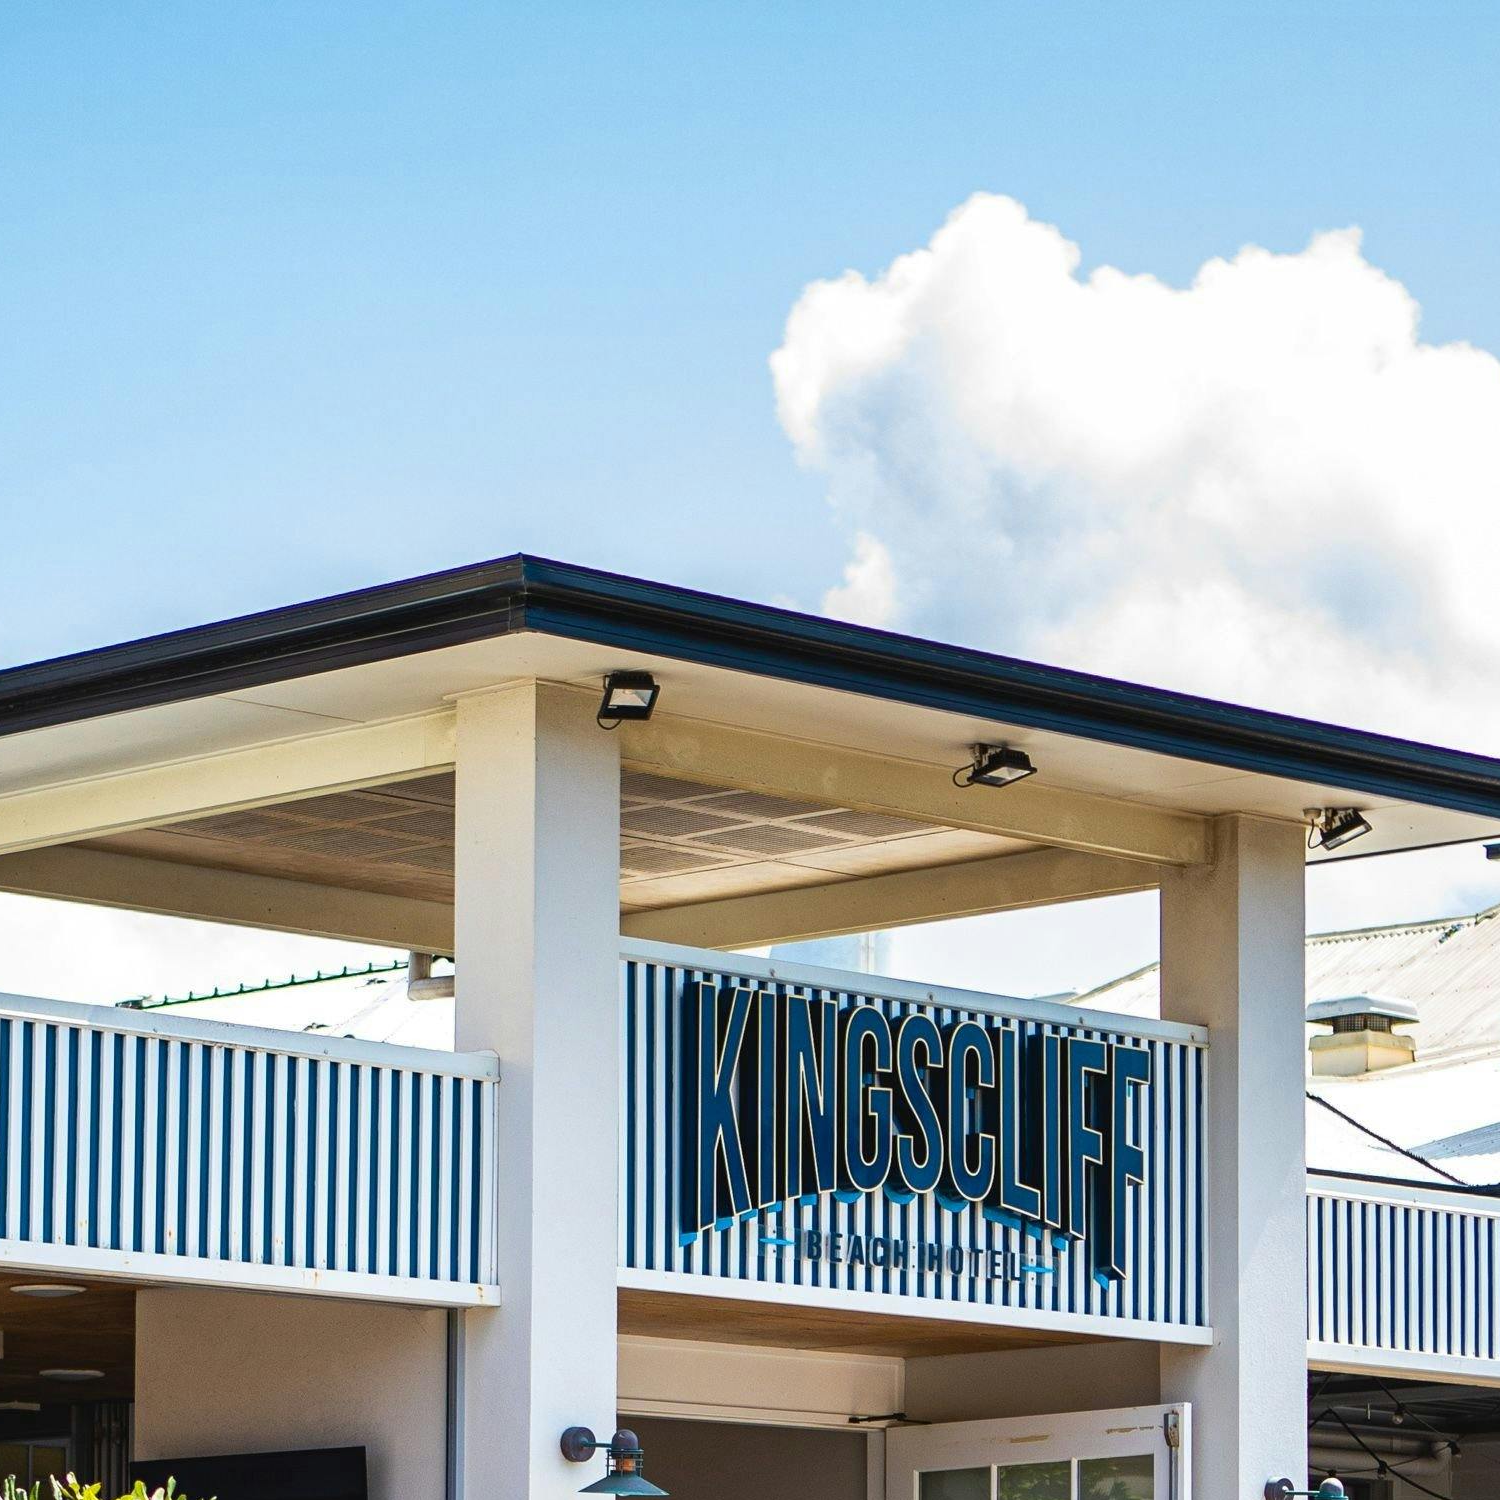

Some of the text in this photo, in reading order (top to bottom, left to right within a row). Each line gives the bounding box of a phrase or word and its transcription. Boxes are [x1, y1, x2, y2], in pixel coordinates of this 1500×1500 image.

[682, 981, 1151, 1279] KINGSCLIFF
[806, 1229, 1021, 1281] BEACH HOTEL
